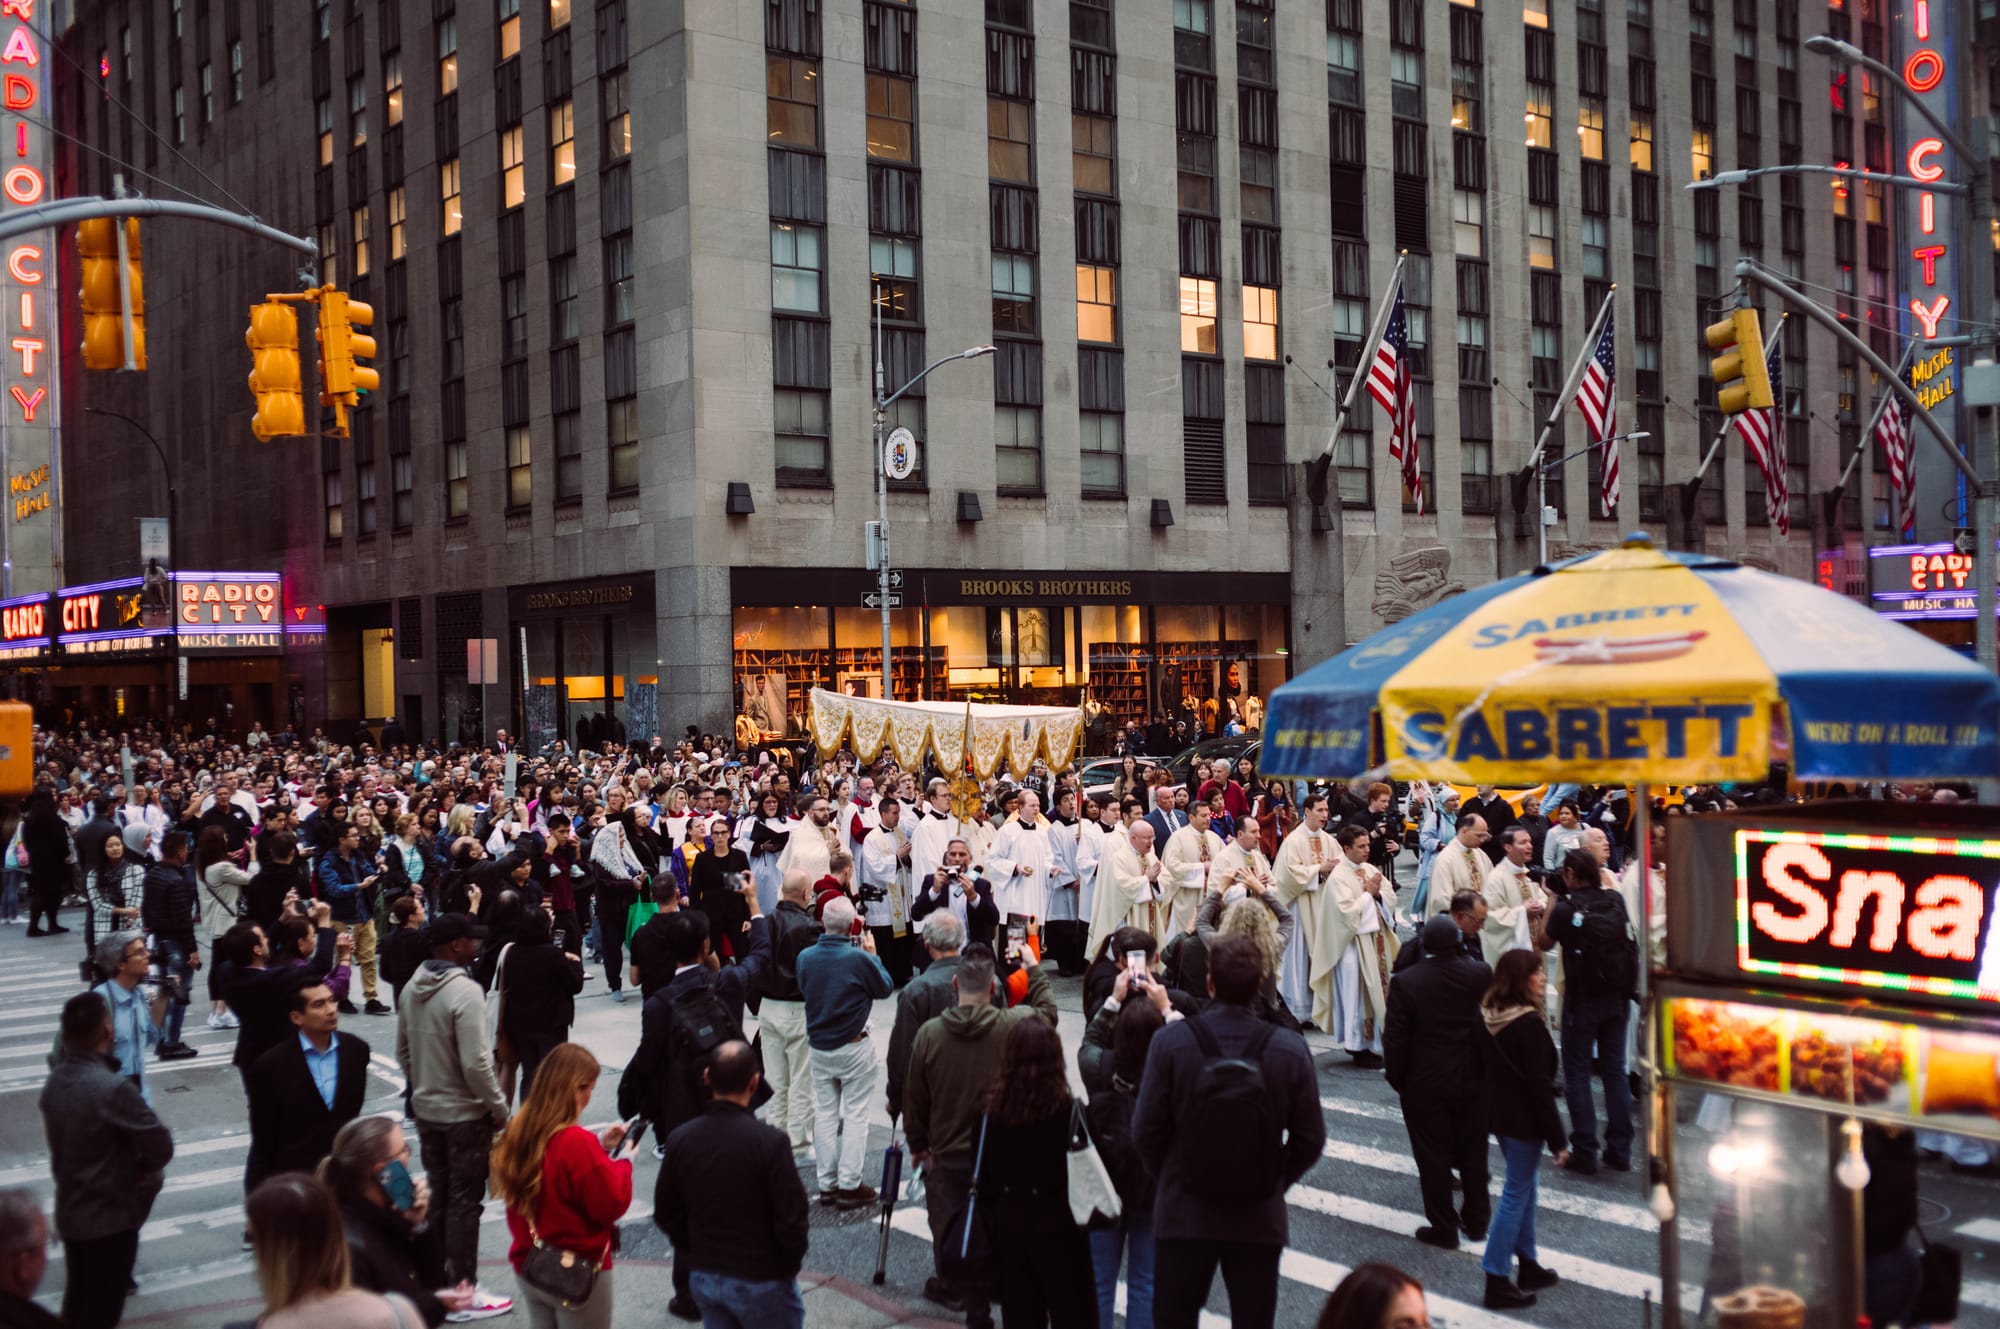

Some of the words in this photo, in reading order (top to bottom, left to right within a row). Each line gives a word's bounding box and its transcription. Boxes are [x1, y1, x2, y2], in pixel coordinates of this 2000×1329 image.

[2, 0, 44, 204] RADIO
[1908, 138, 1949, 339] CITY
[8, 245, 46, 421] CITY
[1911, 346, 1953, 389] MUSIC
[1918, 377, 1955, 410] HALL
[1911, 553, 1973, 572] RADI
[181, 583, 275, 603] RADIO
[960, 580, 1034, 596] BROOKS
[1038, 580, 1132, 596] BROTHERS
[1911, 571, 1969, 590] CIT
[3, 602, 45, 640] RADIO
[62, 594, 100, 632] CITY
[182, 604, 274, 623] CITY
[1903, 599, 1946, 610] MUSIC
[1953, 597, 1976, 609] HA
[1472, 603, 1701, 649] SABRETT
[178, 634, 228, 647] MUSIC
[236, 634, 280, 647] HALL
[1403, 702, 1755, 763] SABRETT
[1905, 724, 1948, 745] ROLL
[1018, 781, 1041, 790] OLICE
[1752, 841, 1984, 961] Sna
